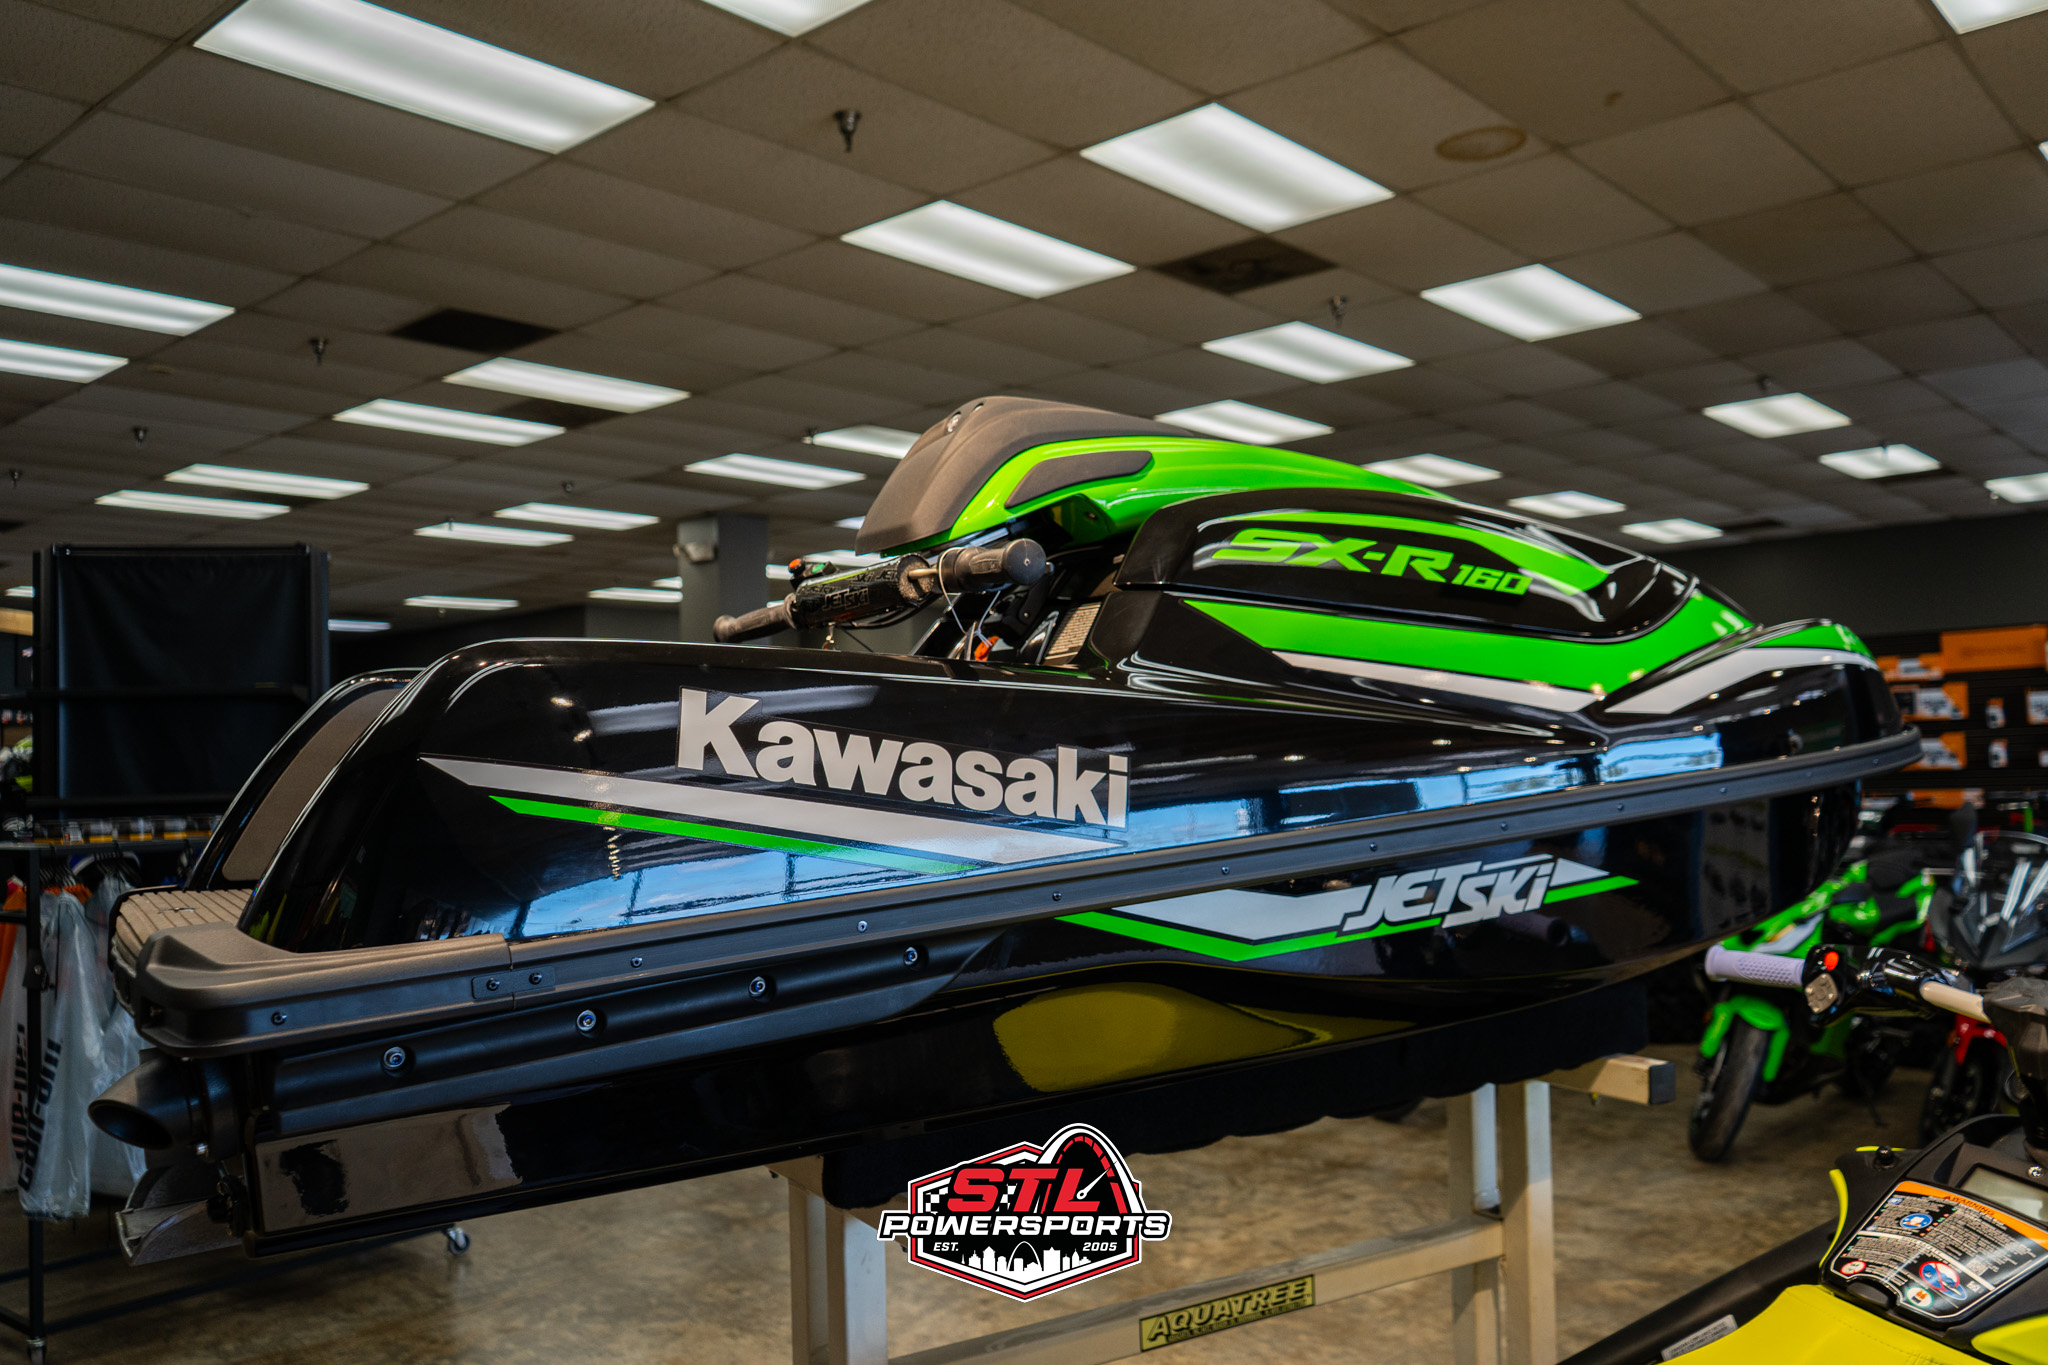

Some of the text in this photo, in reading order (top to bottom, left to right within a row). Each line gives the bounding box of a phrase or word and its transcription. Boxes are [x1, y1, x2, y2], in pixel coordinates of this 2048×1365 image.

[1211, 528, 1533, 596] SX-R 160
[677, 687, 1129, 829] Kawasaki
[1951, 1196, 1995, 1217] WARNING
[1147, 1280, 1307, 1341] AQUATREE
